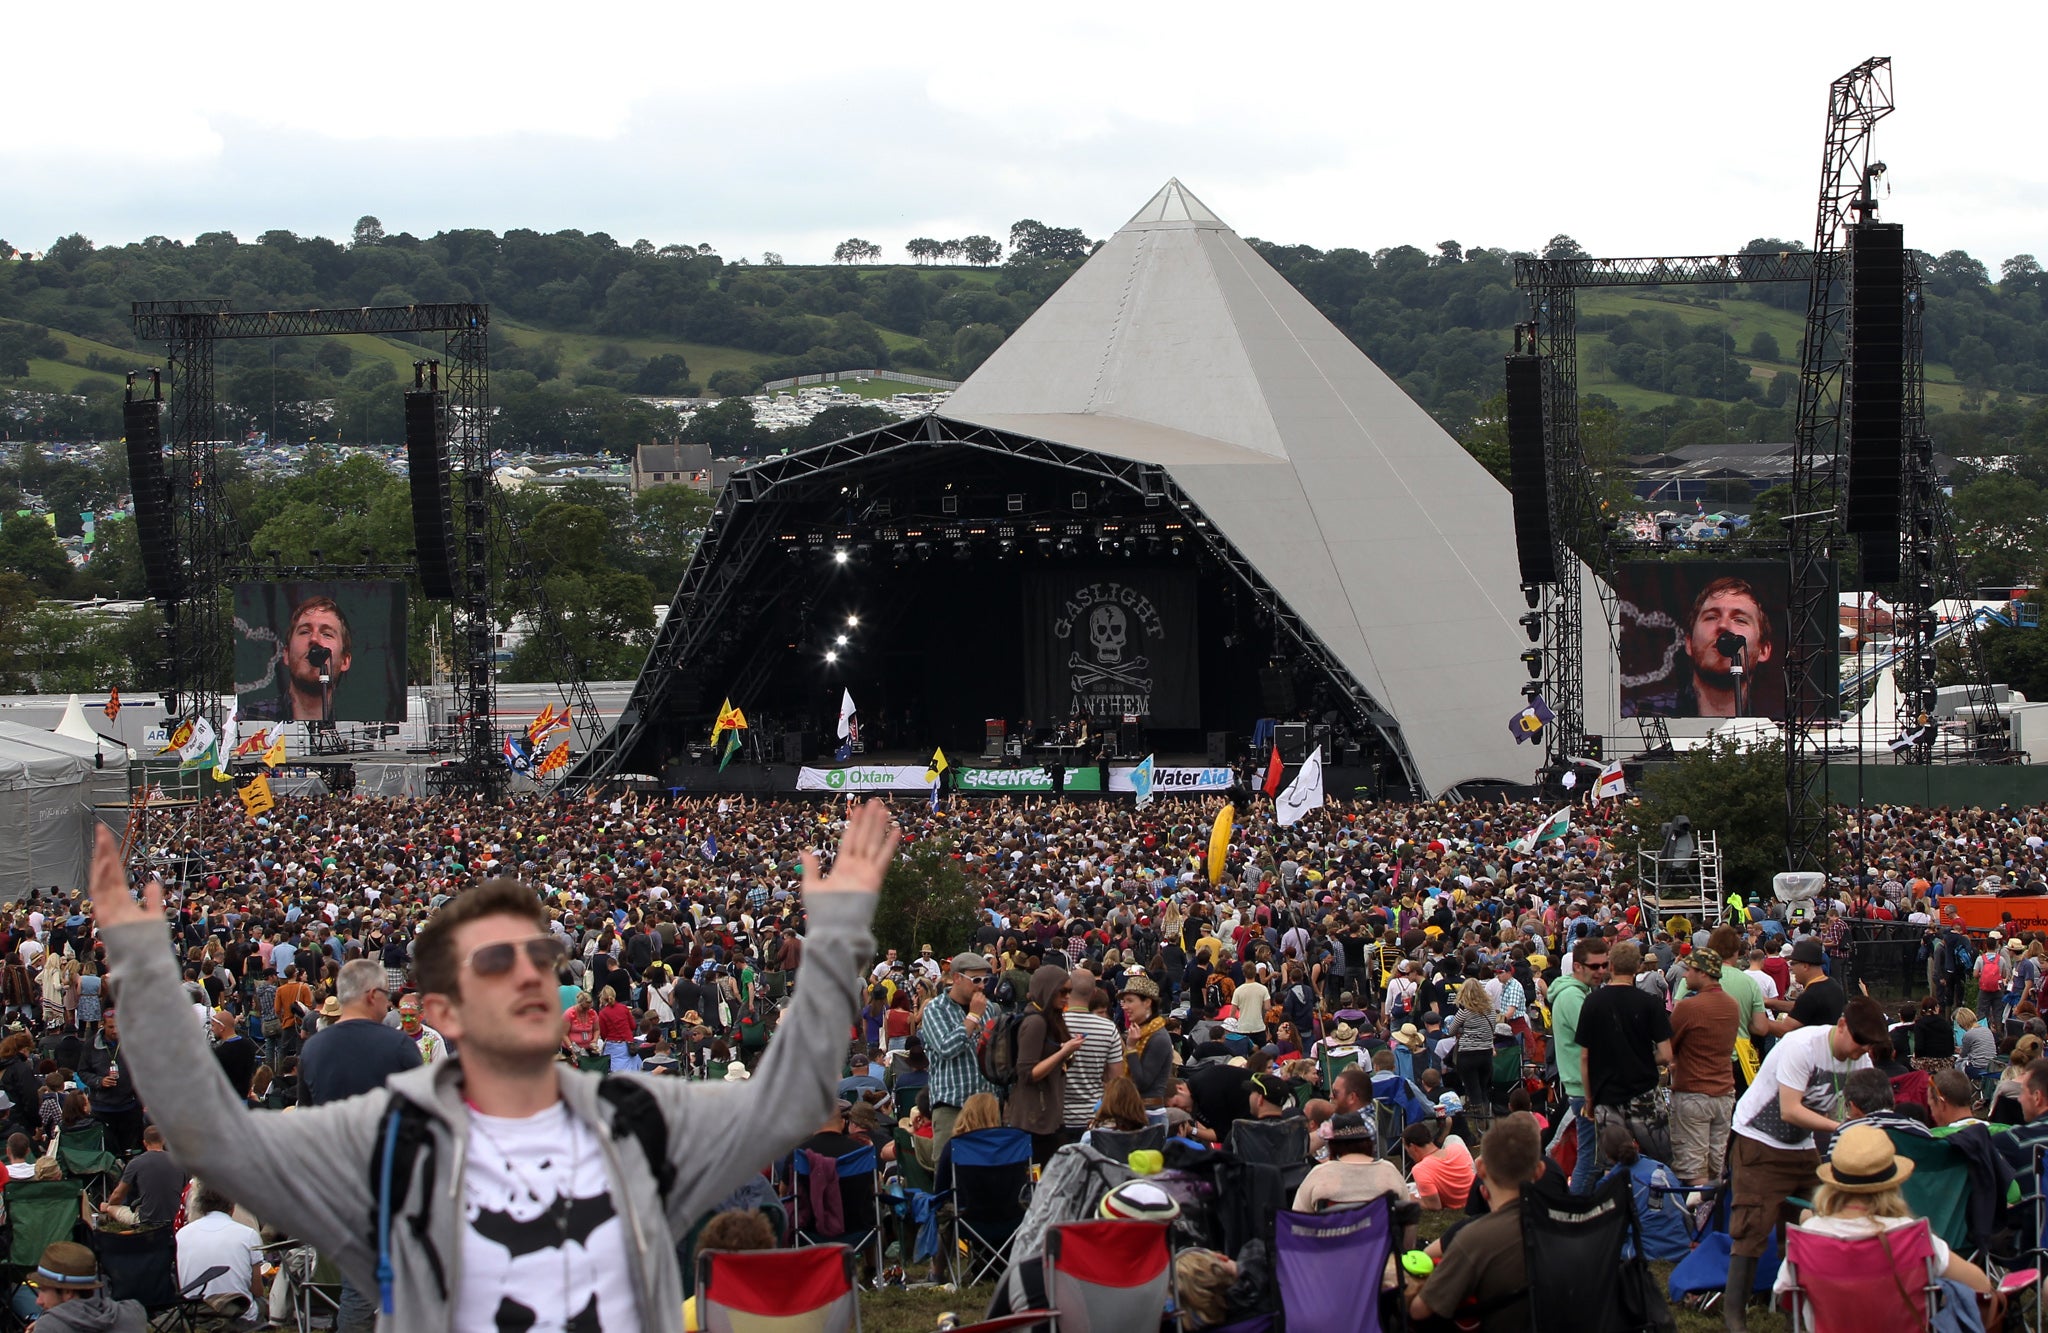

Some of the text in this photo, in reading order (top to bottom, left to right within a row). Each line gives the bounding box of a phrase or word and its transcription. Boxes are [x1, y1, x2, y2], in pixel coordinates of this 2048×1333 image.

[1054, 583, 1165, 640] GASLIGHT
[1070, 695, 1151, 716] ANTHEM
[849, 770, 895, 784] Oxfam
